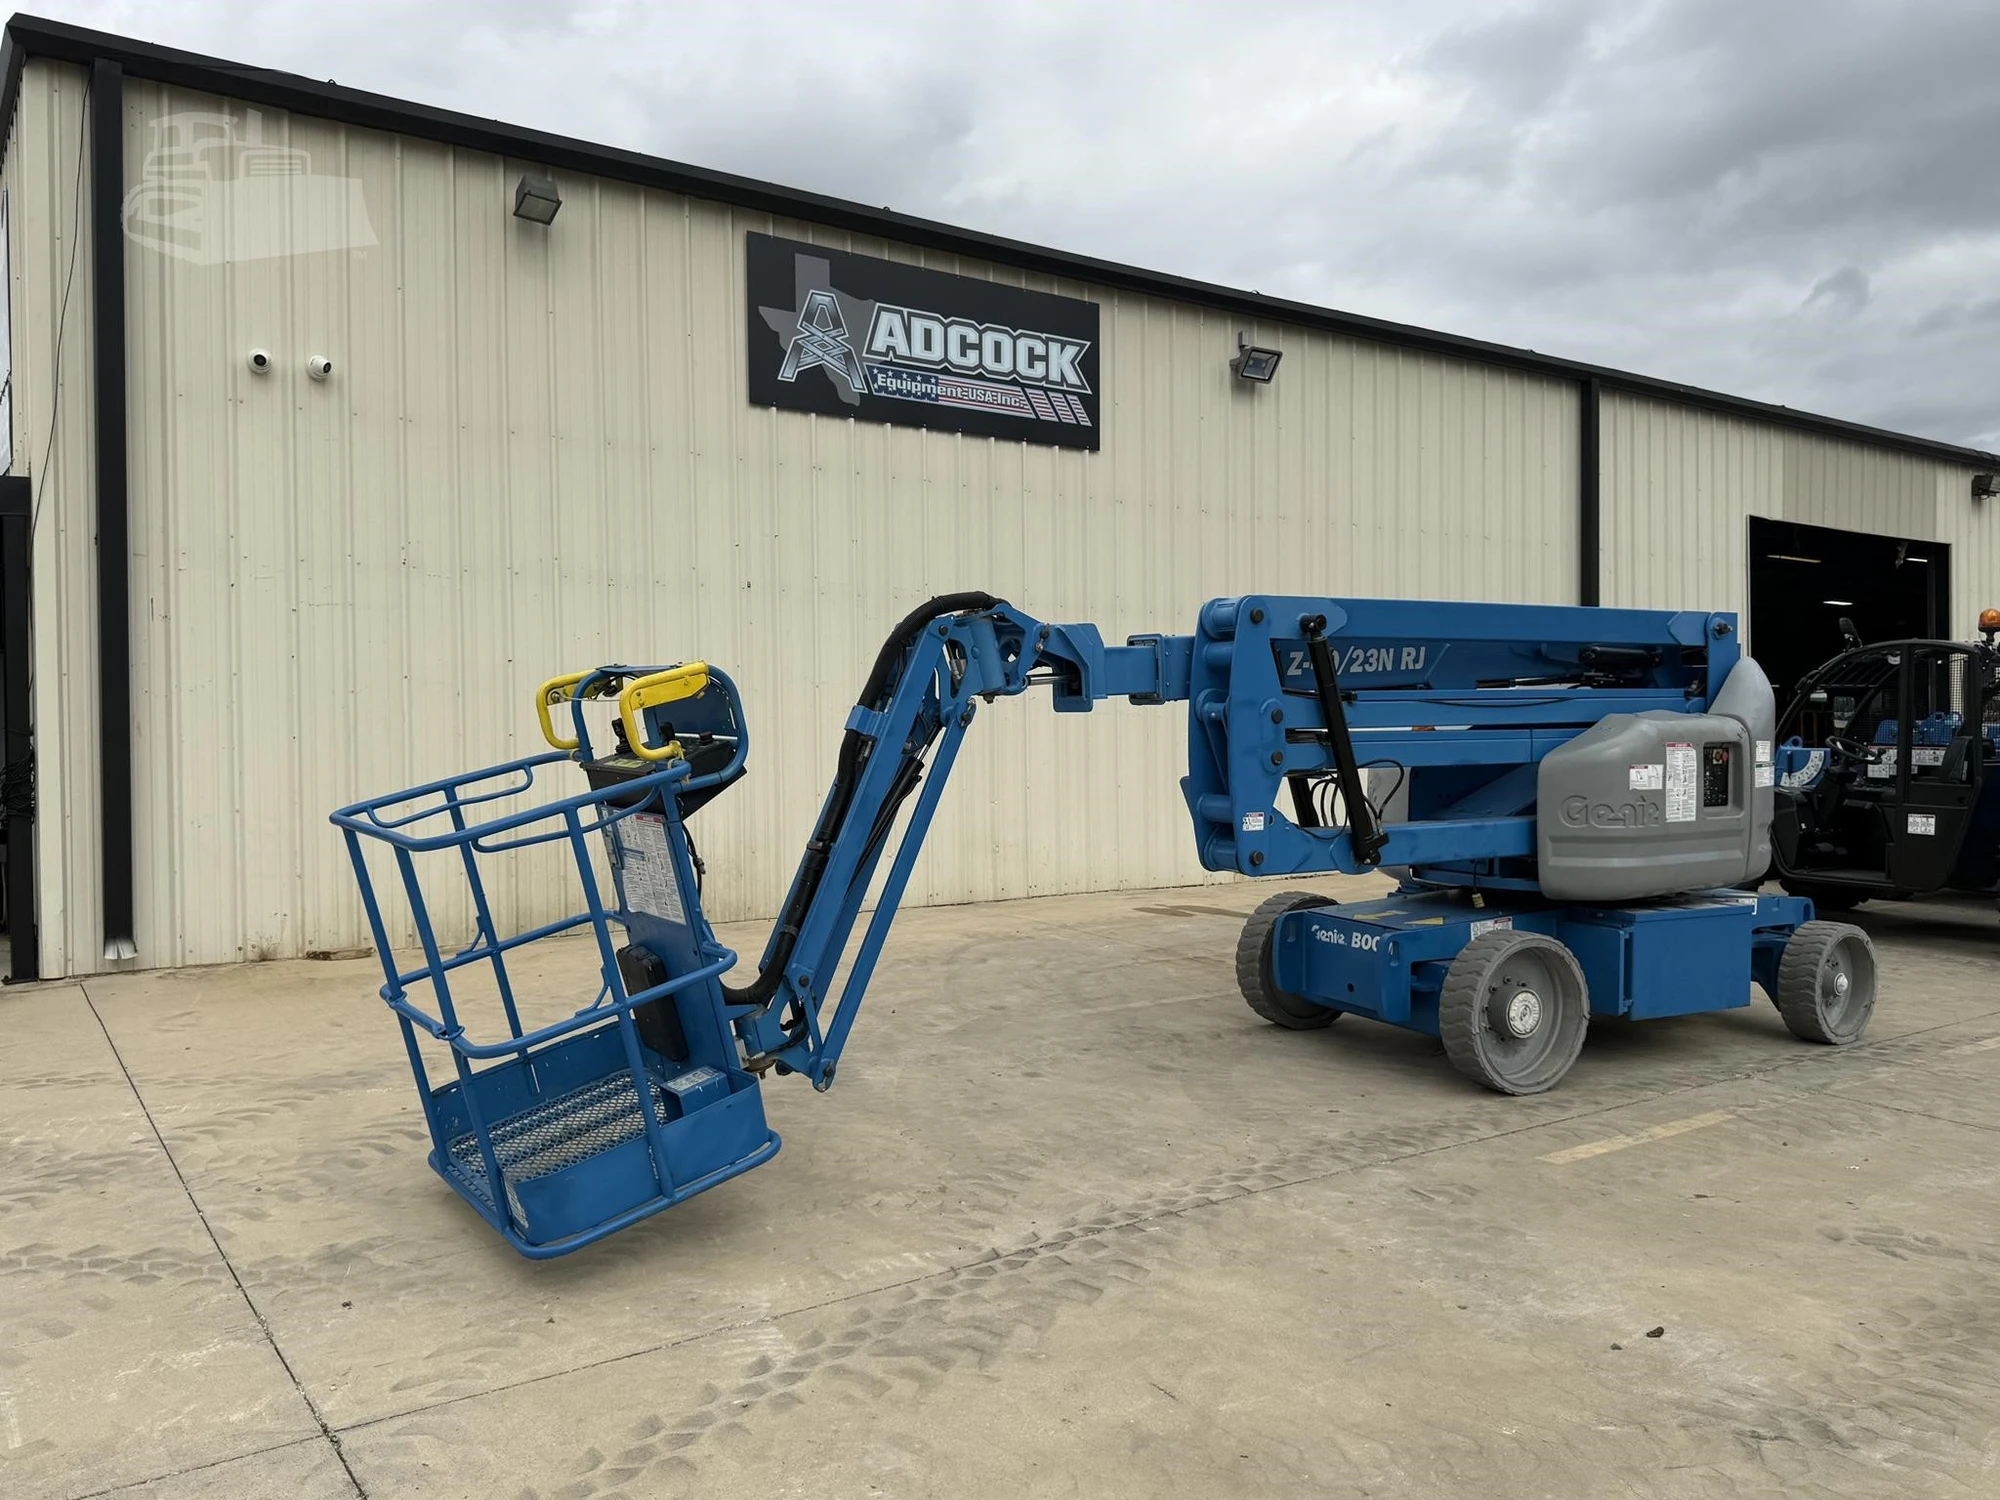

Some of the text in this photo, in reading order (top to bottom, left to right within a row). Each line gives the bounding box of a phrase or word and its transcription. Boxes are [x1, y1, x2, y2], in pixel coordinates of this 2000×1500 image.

[866, 305, 1087, 390] ADCOCK
[877, 373, 1025, 408] Equipment USA Inc.
[1287, 646, 1427, 676] Z-/23N RJ
[1558, 795, 1660, 828] Genie
